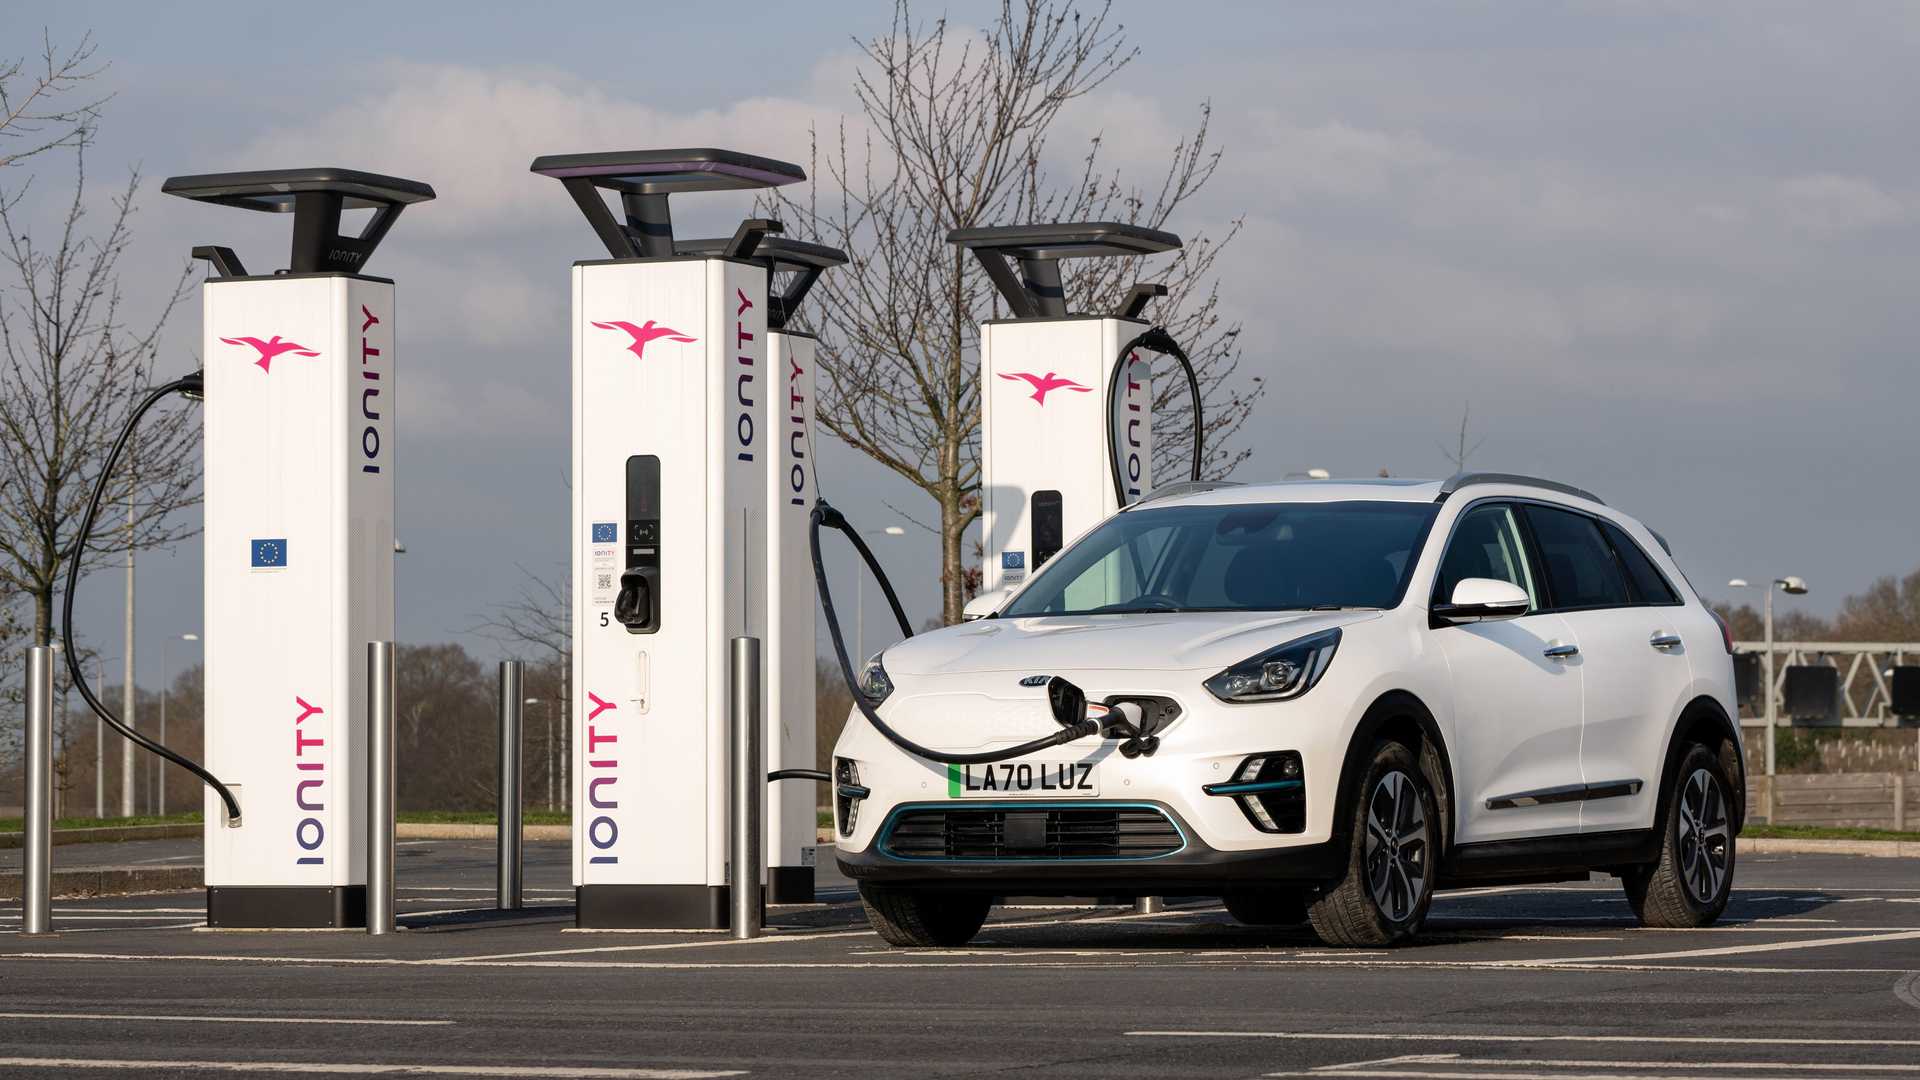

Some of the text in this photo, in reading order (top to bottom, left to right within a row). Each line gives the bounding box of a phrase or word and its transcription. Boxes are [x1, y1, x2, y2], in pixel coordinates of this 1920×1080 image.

[362, 303, 380, 474] IONITY
[737, 287, 754, 462] IONITY
[790, 356, 805, 506] IONITY
[1127, 350, 1141, 496] IONITY
[599, 612, 609, 628] 5
[295, 695, 325, 865] IONITY
[588, 690, 619, 864] IONITY
[965, 763, 1093, 791] LA70 LUZ
